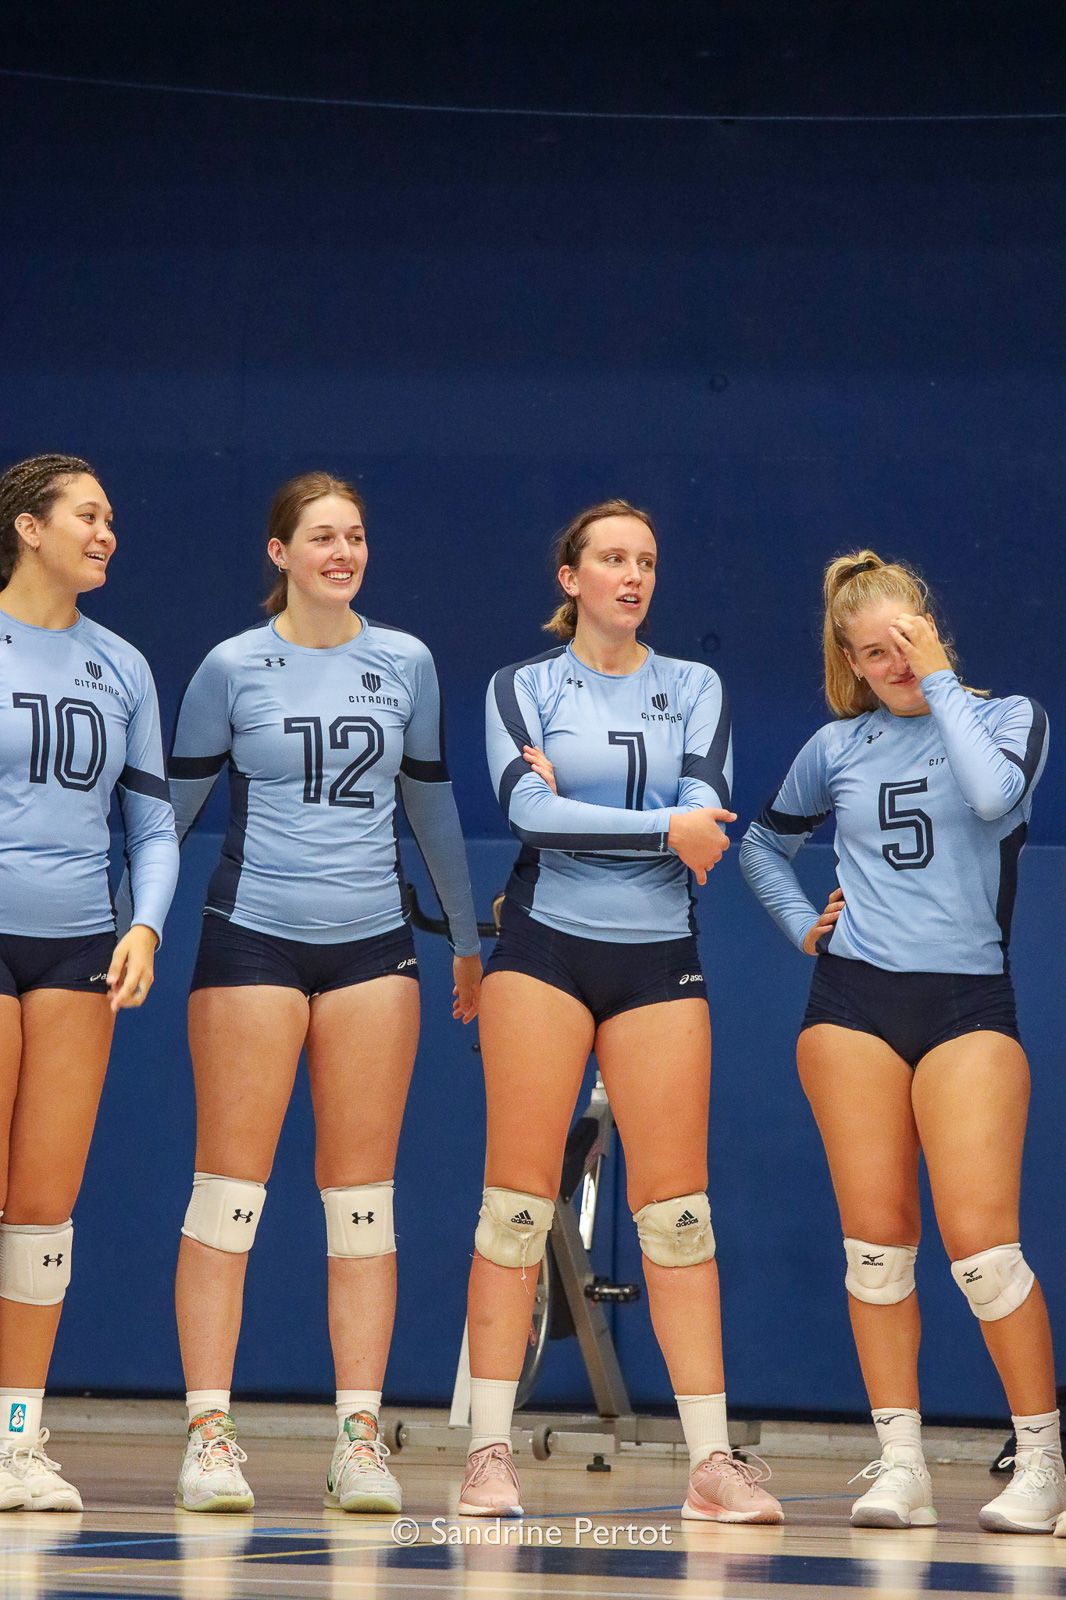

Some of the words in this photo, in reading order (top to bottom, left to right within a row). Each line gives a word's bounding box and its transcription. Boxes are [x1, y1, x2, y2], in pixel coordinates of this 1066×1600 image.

[348, 695, 399, 708] CITADINS
[641, 712, 683, 724] CITADNS
[12, 692, 107, 793] 10
[283, 716, 385, 809] 12
[878, 777, 935, 872] 5
[510, 1217, 535, 1226] adidas
[676, 1217, 699, 1228] adidas
